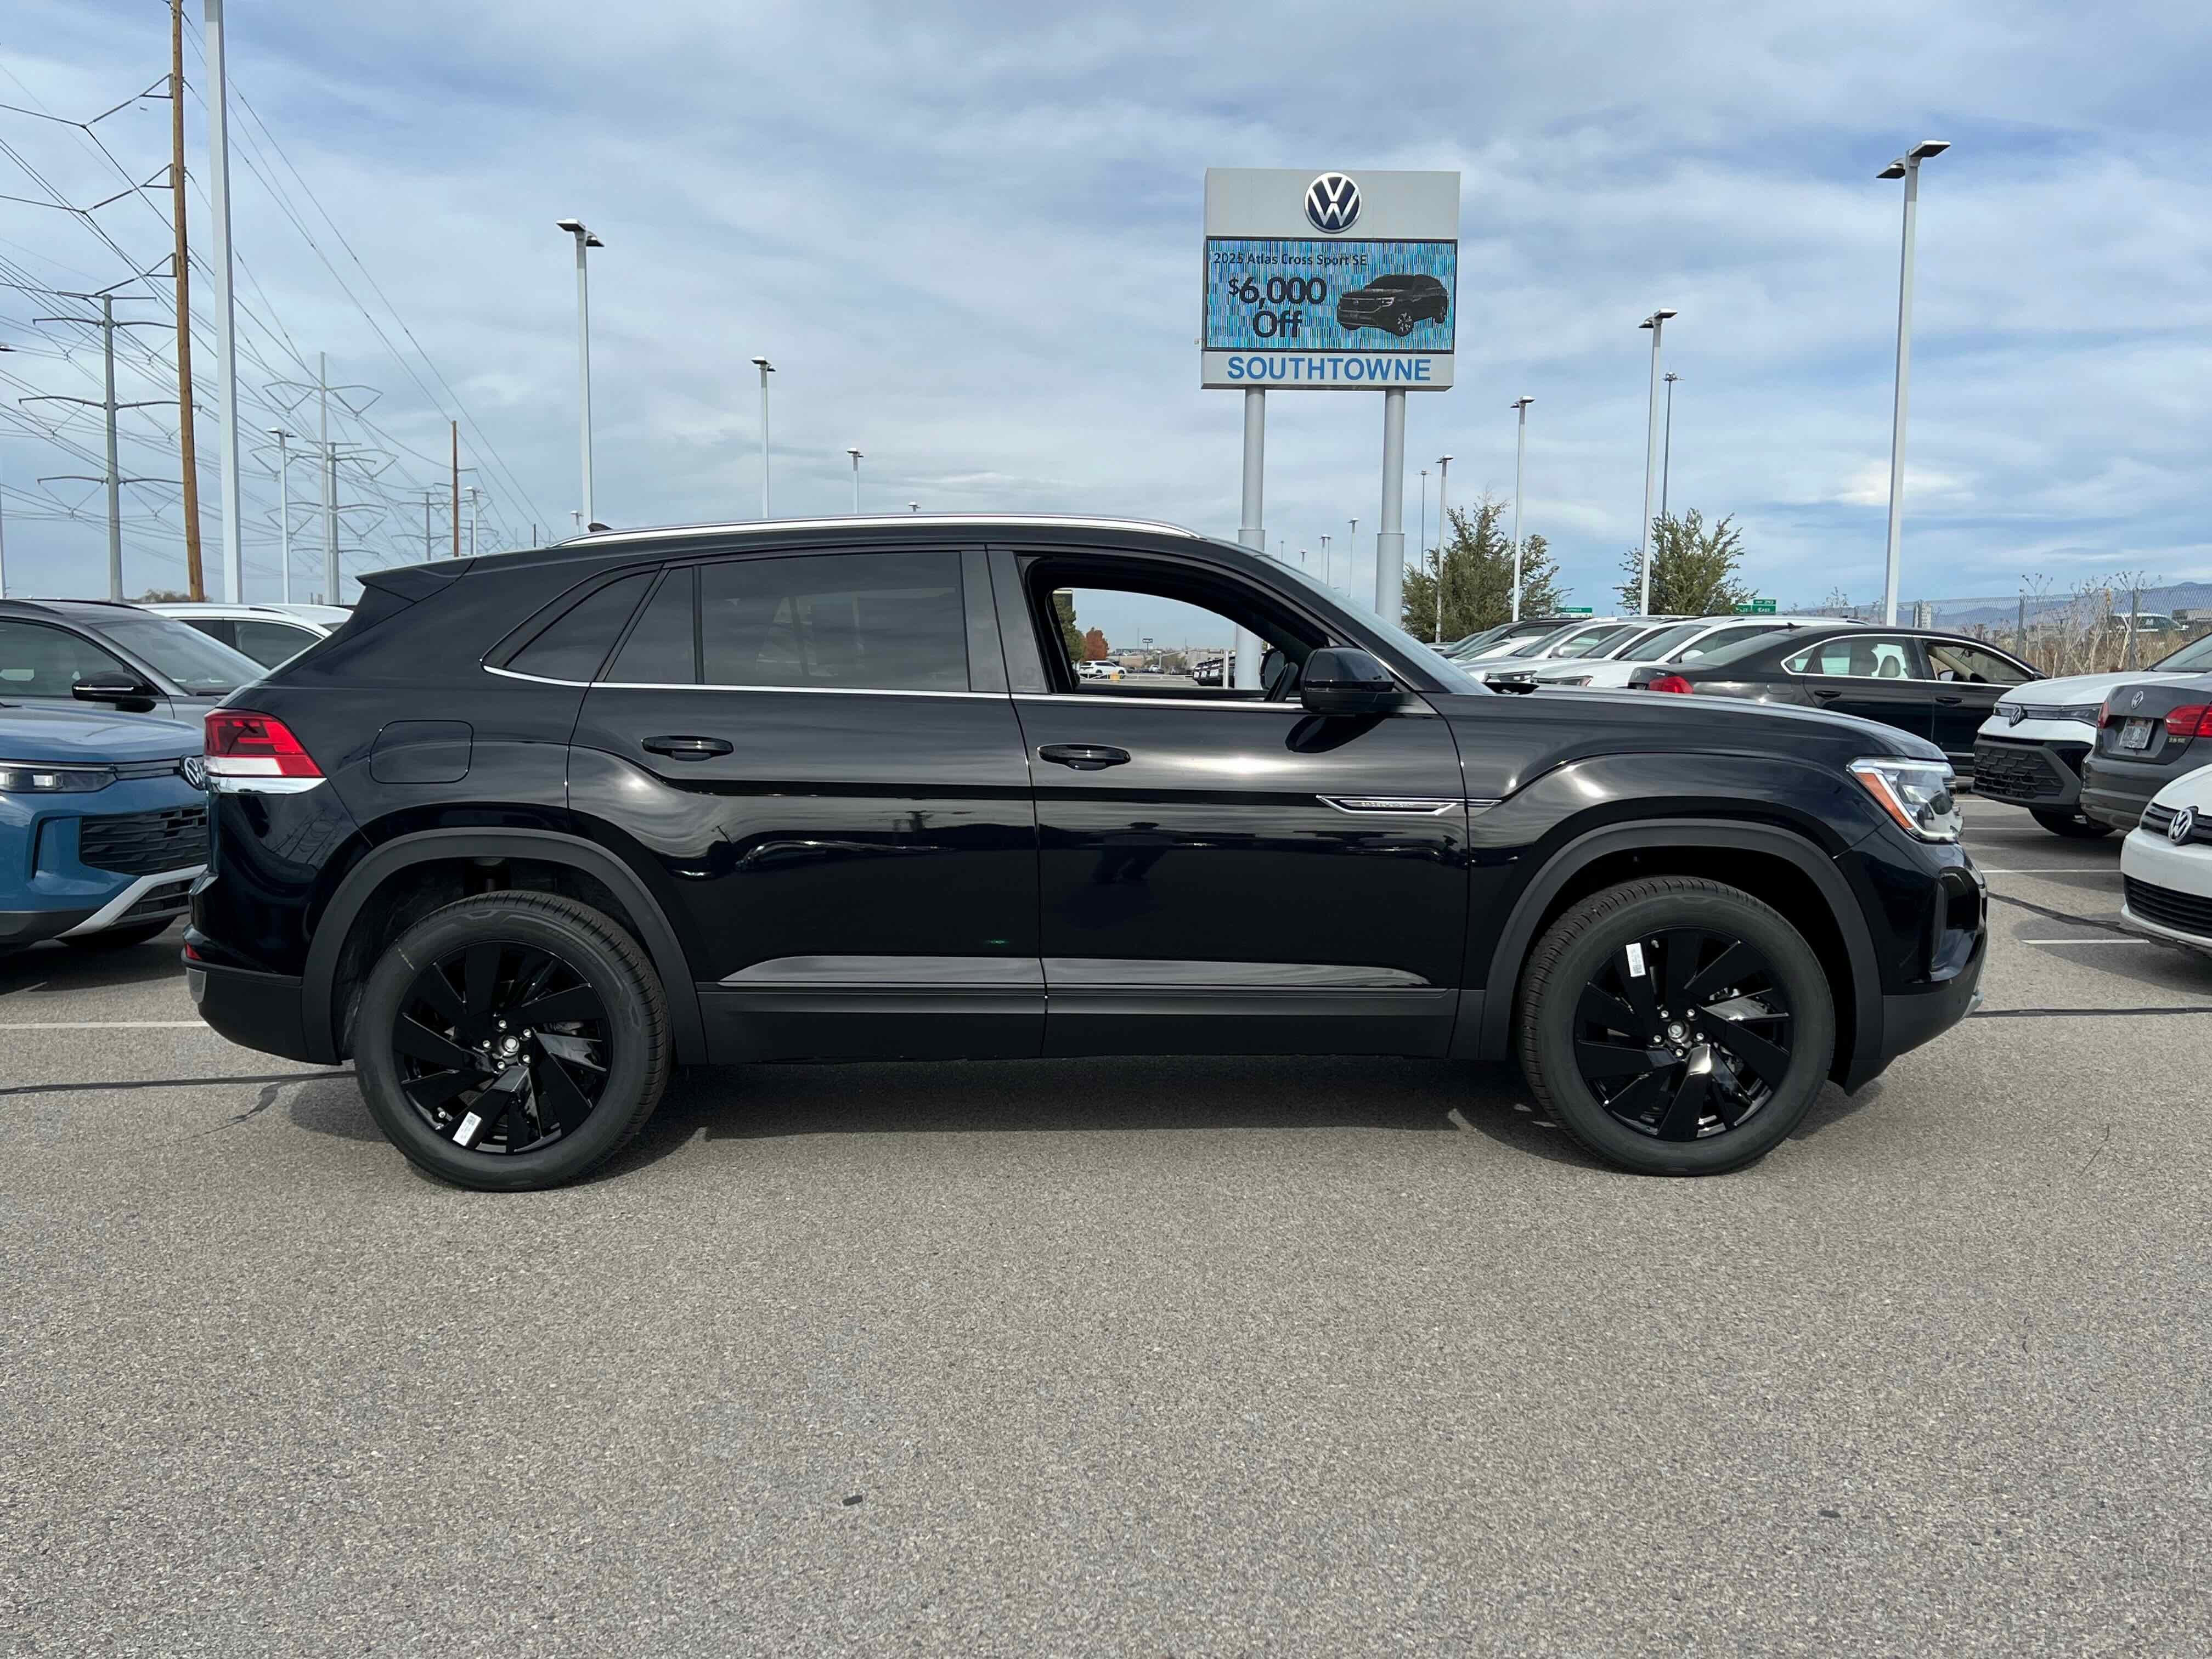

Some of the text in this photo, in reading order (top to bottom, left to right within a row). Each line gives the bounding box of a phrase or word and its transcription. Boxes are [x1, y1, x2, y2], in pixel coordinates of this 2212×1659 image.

[1306, 172, 1361, 232] VW
[1248, 253, 1278, 264] Atlas
[1281, 253, 1313, 264] Cross
[1317, 254, 1350, 268] Sport
[1352, 254, 1368, 266] SE
[1228, 276, 1327, 310] $6,000
[1252, 310, 1303, 338] Off
[1227, 357, 1431, 381] SOUTHTOWNE
